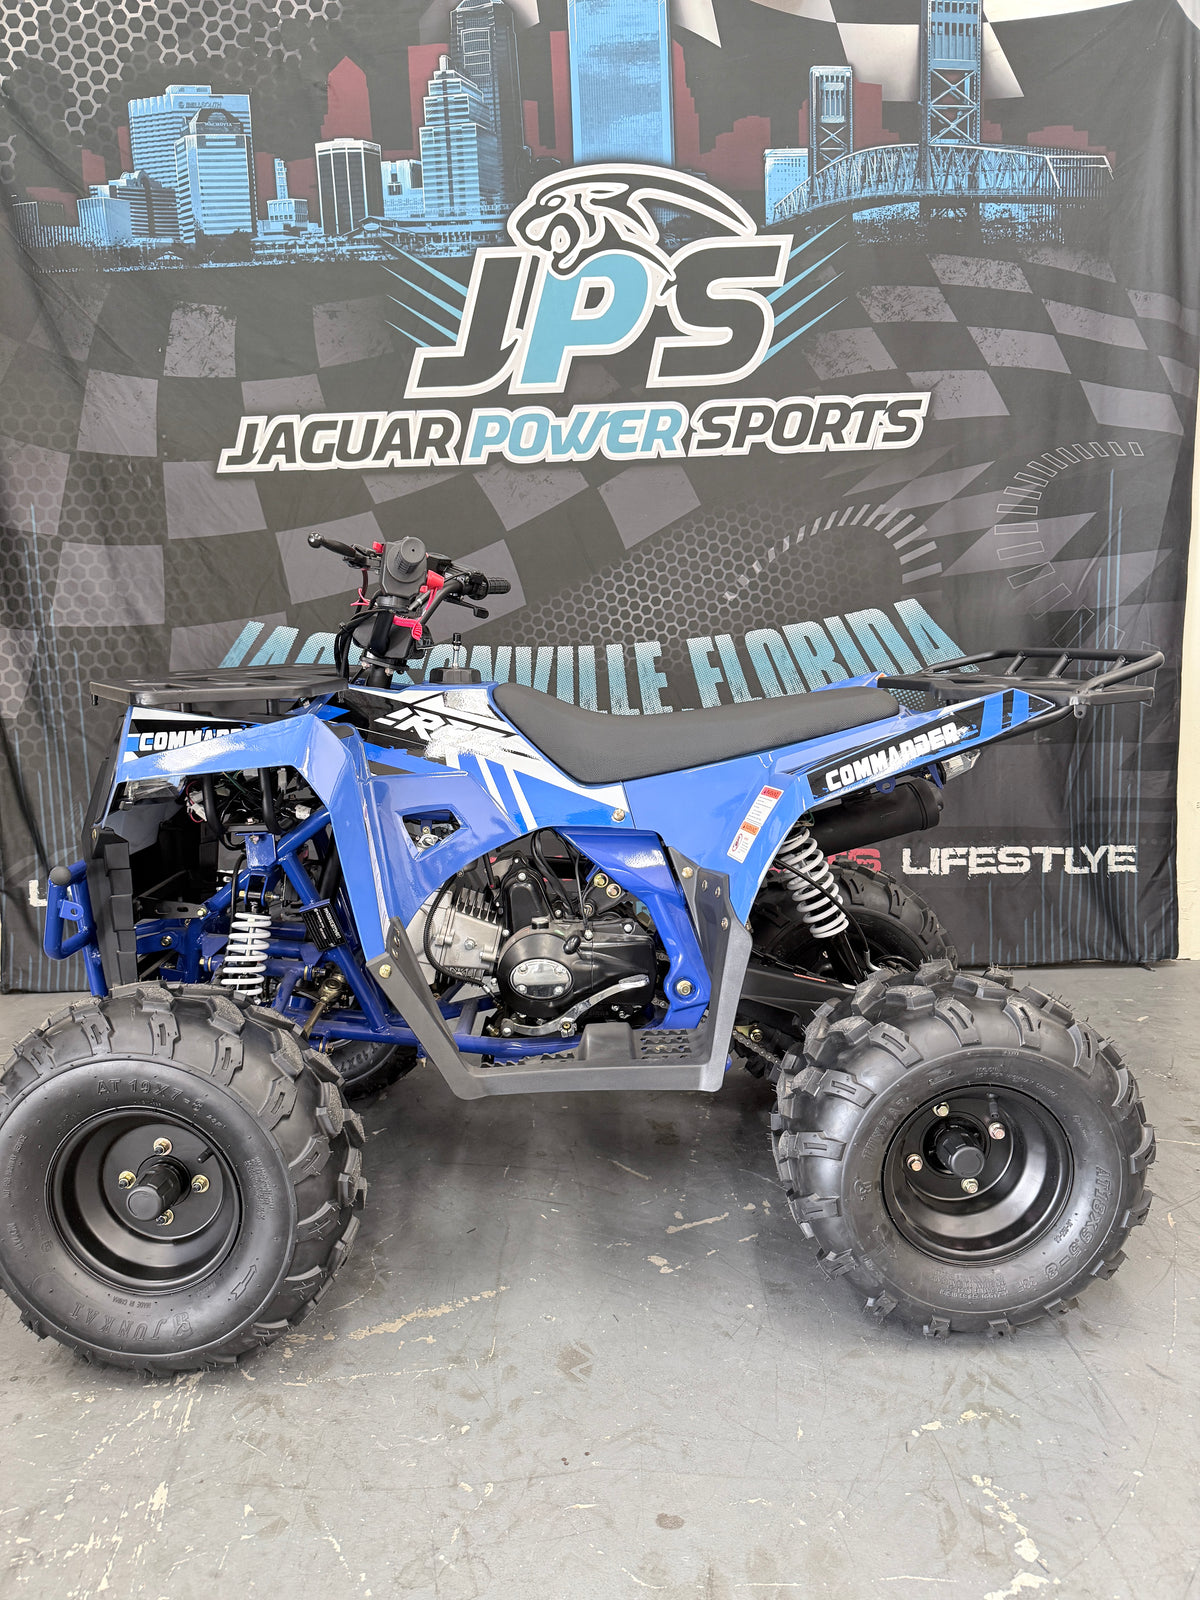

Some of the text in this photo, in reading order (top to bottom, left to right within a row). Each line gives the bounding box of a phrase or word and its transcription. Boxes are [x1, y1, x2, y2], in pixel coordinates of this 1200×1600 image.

[406, 238, 790, 397] JPS
[220, 393, 929, 472] JAGUAR POWER SPORTS
[825, 721, 962, 792] COMMANDER
[902, 844, 1138, 876] LIFESTLYE
